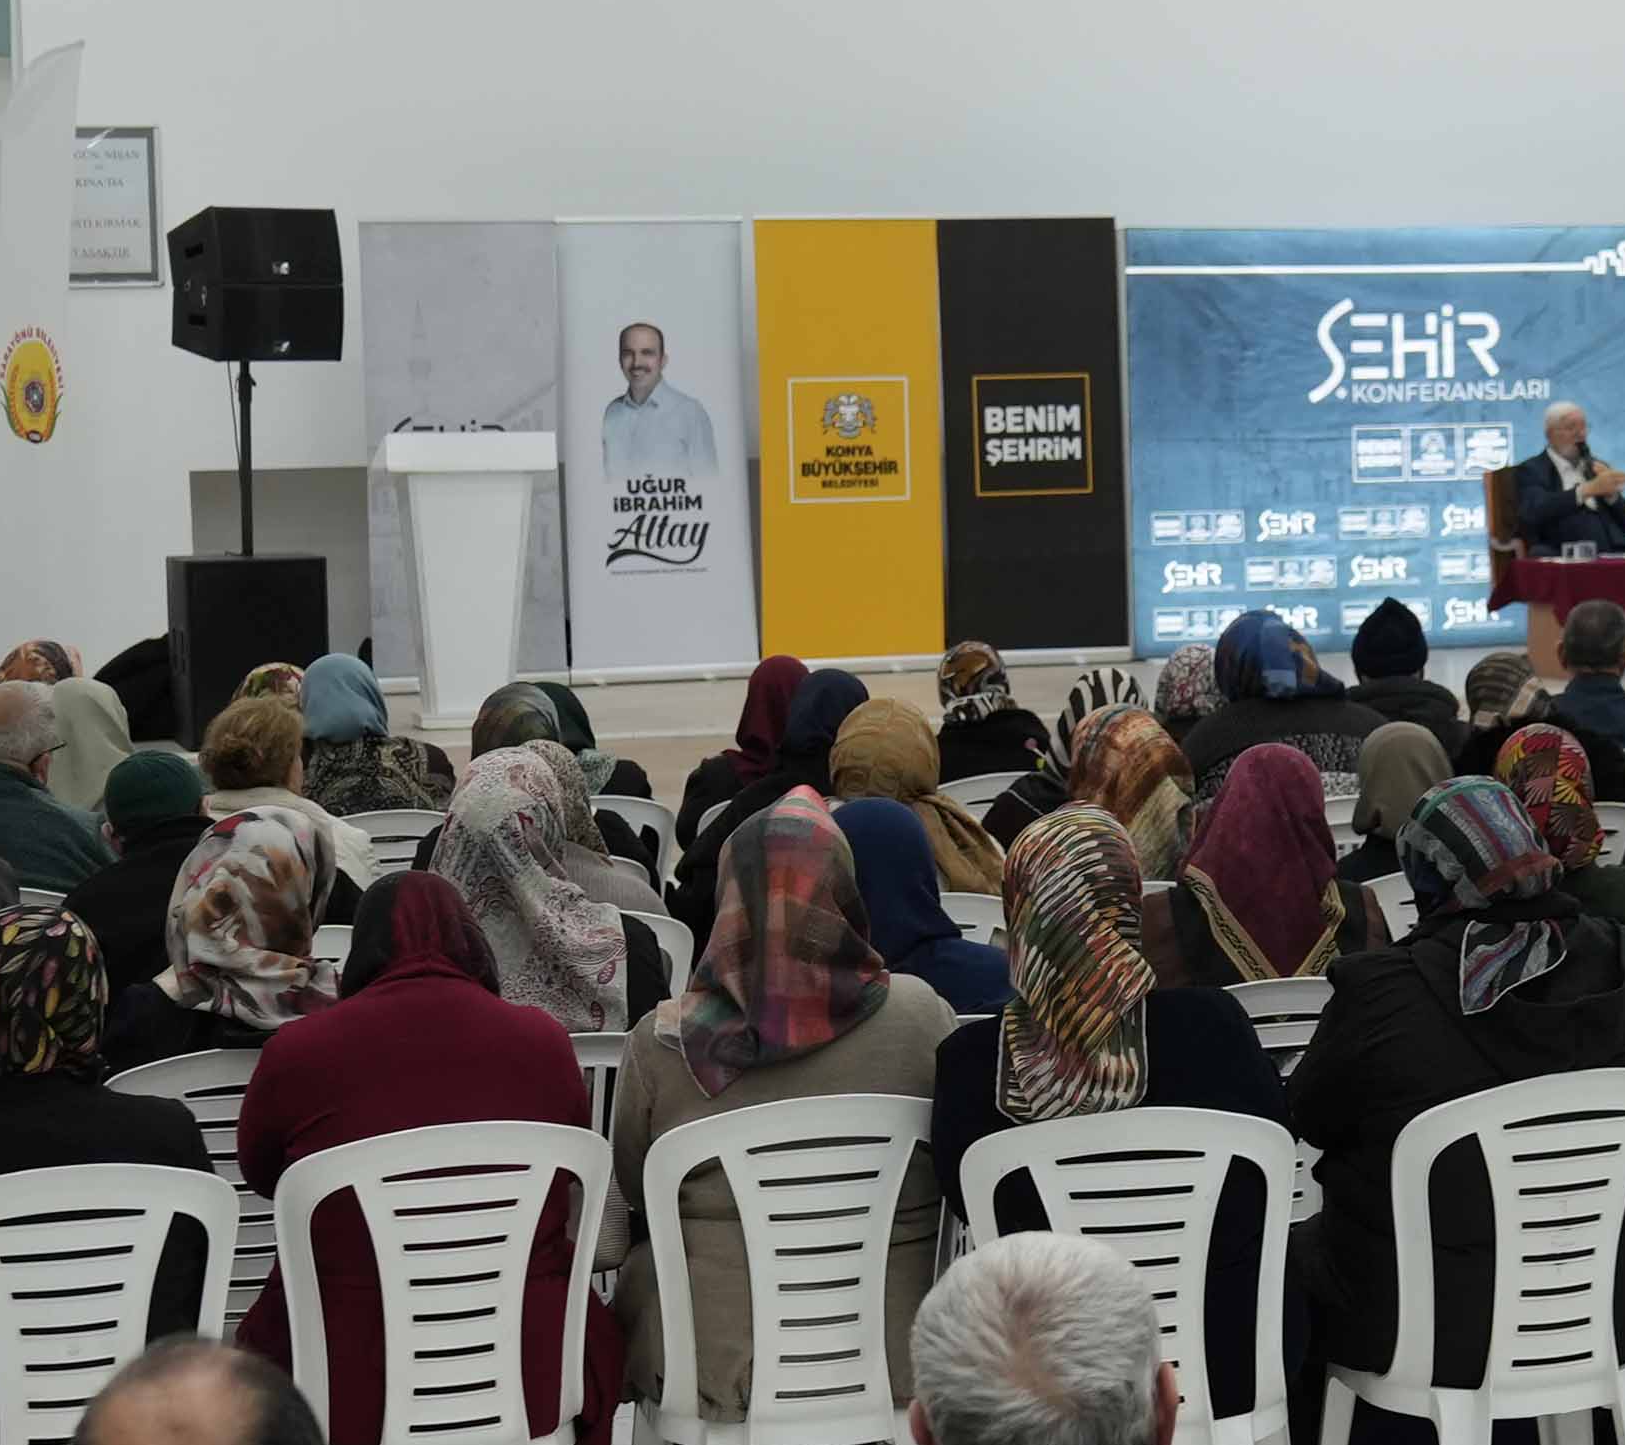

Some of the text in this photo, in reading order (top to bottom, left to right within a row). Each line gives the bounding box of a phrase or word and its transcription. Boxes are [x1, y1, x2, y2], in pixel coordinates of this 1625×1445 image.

[1352, 379, 1551, 405] KONFERANSLARI
[984, 404, 1081, 434] BENİM
[825, 445, 873, 457] KONYA
[985, 436, 1082, 467] ŞEHRİM
[801, 458, 899, 477] BÜYÜKŞEHİR
[627, 473, 687, 494] UĞUR
[613, 495, 703, 513] İBRAHİM
[606, 514, 710, 567] Altay
